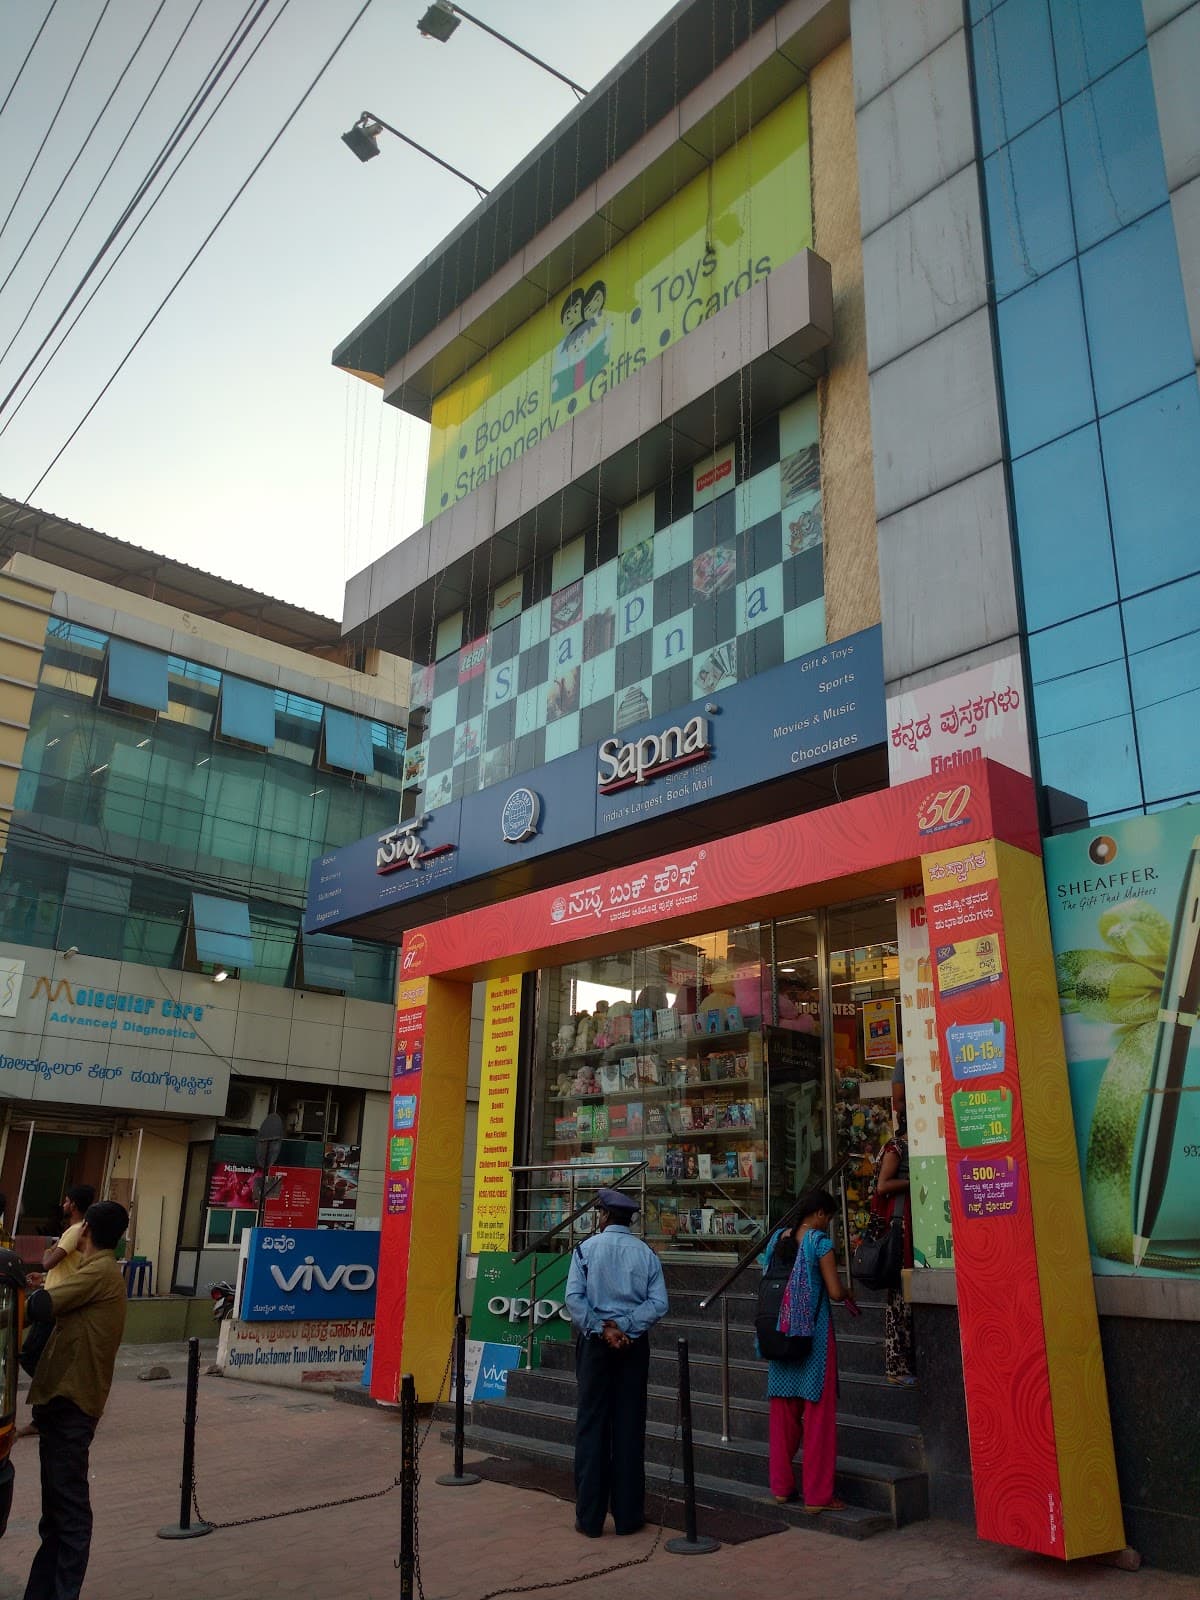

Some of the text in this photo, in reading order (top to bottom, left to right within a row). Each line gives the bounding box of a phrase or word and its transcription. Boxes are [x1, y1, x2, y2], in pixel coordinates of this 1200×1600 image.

[650, 248, 717, 313] Toys
[682, 255, 771, 335] Cards
[588, 343, 647, 402] Gifts
[474, 389, 540, 456] Books
[456, 408, 560, 502] Stationery
[801, 646, 854, 672] Gift & Toys
[818, 673, 855, 693] Sports
[773, 702, 857, 739] Movies & Music
[892, 686, 1020, 751] ಕನ್ನಡ ಪುಸ್ತಕಗಳು
[598, 716, 710, 784] Sapna
[791, 734, 859, 763] Chocolates
[931, 747, 982, 775] Fiction
[603, 776, 713, 823] India's Largest Book Mall
[919, 785, 971, 830] 50
[1062, 886, 1157, 912] The Gift That Matters
[50, 1012, 197, 1040] Advanced Diagnostics
[162, 1000, 204, 1022] Care
[270, 1256, 376, 1291] vivo
[229, 1348, 254, 1368] Sapna
[255, 1345, 291, 1365] Customer
[308, 1345, 337, 1364] Wheeler
[339, 1343, 368, 1366] Parking
